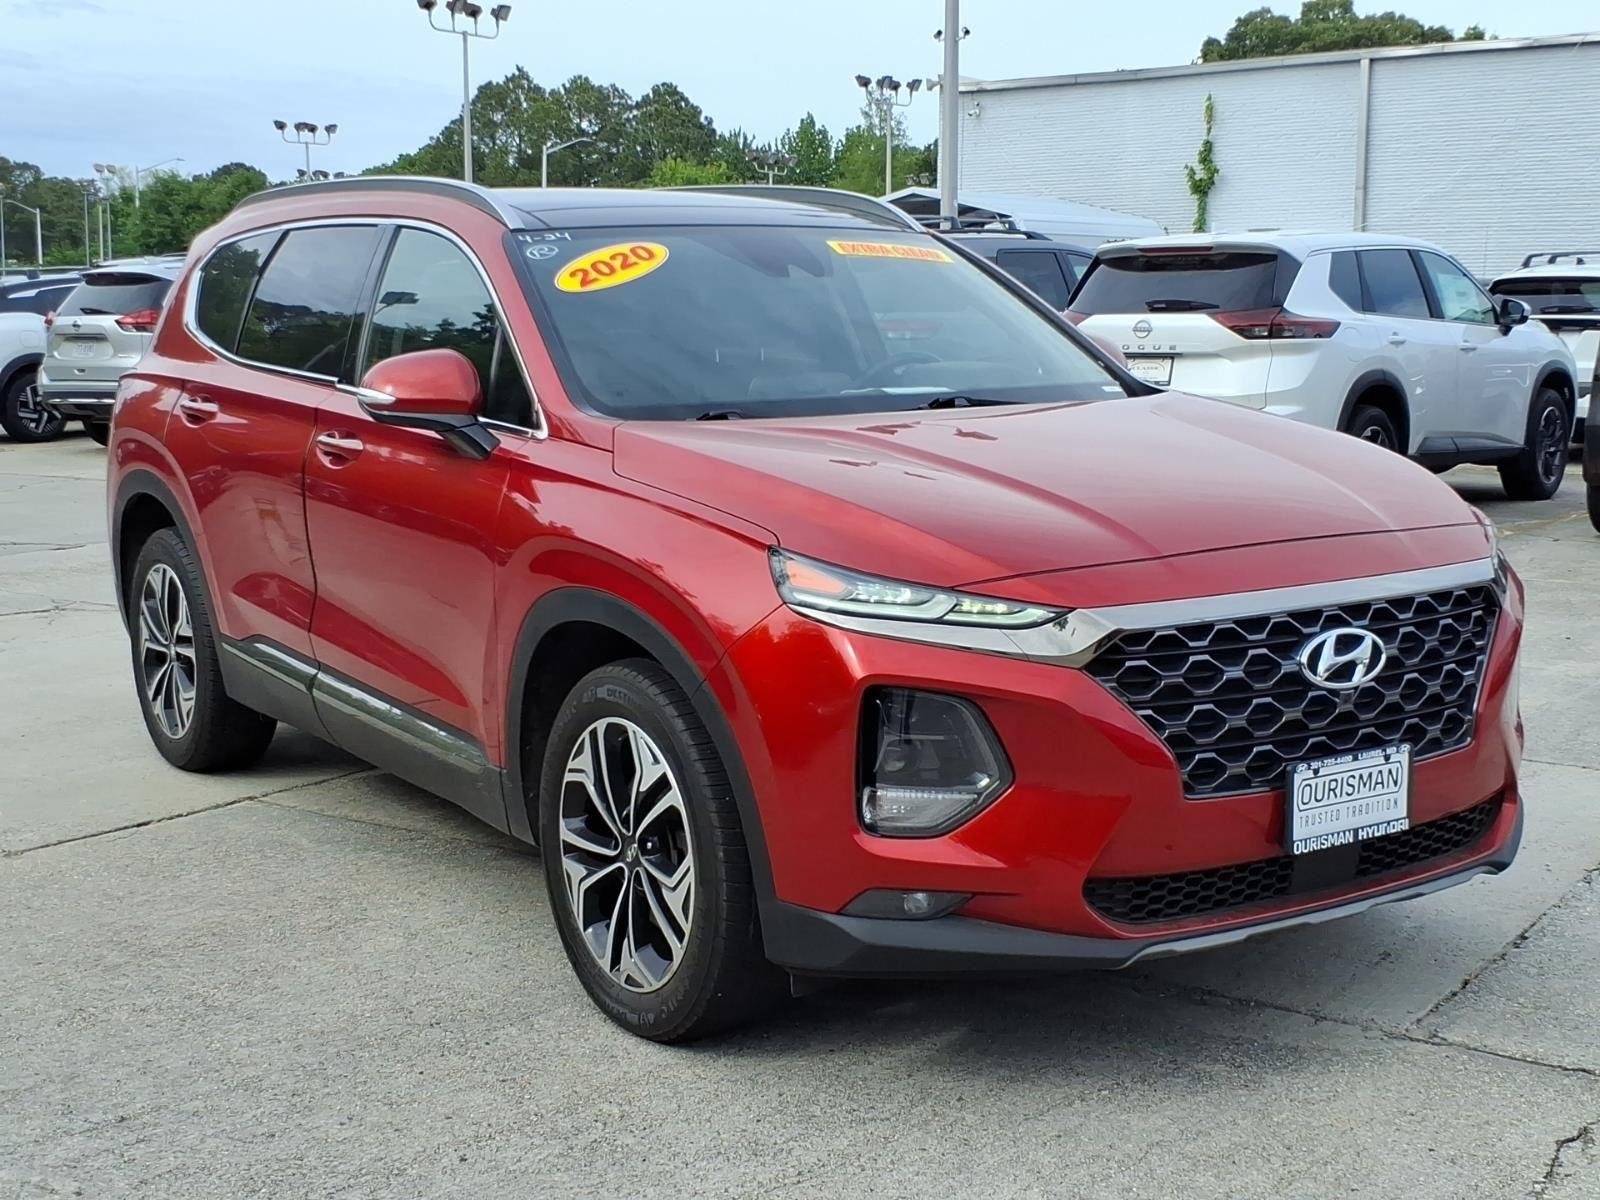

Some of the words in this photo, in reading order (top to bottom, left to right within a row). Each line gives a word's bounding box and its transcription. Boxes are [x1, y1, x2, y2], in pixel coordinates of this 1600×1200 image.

[569, 245, 656, 288] 2020
[1300, 767, 1400, 806] OURISMAN
[1300, 808, 1340, 829] TRUSTED
[1346, 797, 1399, 819] TRADITION
[1293, 829, 1354, 855] OURISMAN
[1358, 817, 1409, 840] HYUNDAI
